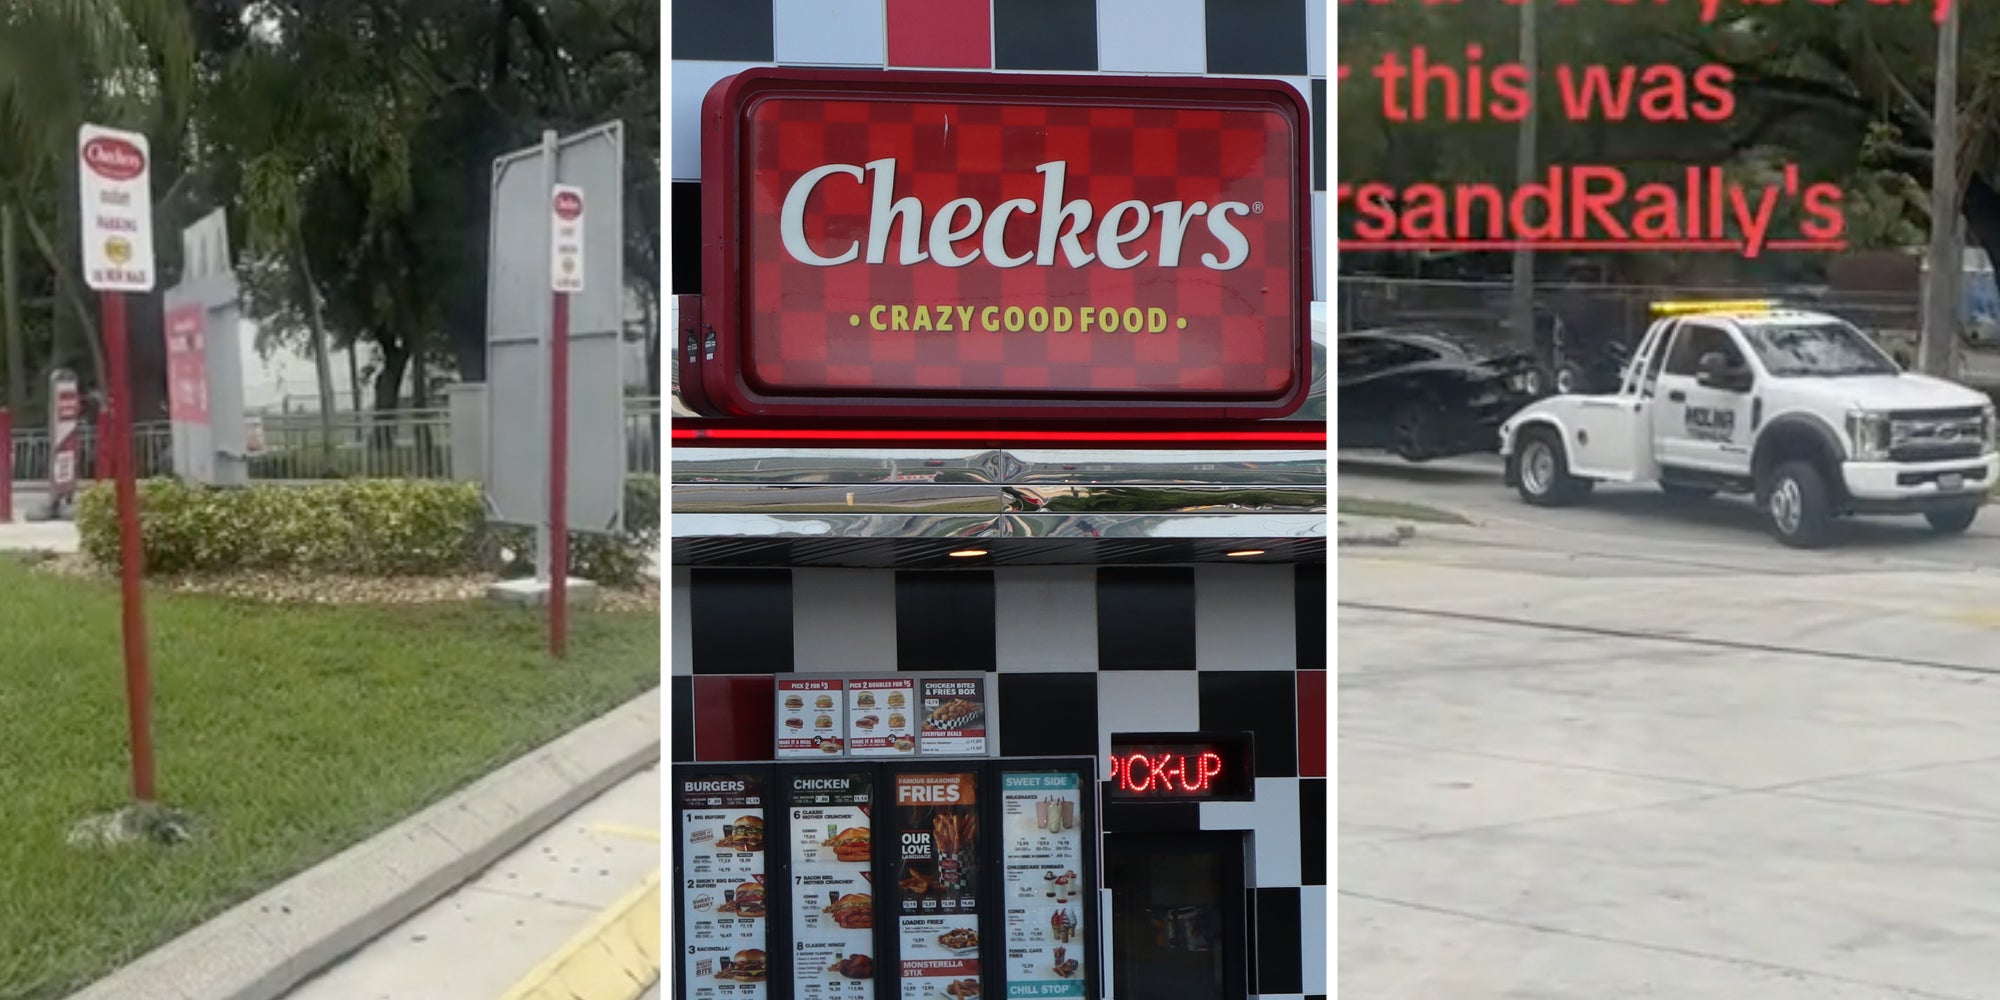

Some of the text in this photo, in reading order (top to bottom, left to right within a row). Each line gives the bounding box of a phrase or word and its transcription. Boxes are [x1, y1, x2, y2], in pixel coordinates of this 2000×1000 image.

[870, 304, 1168, 333] CRAZY GOOD FOOD
[804, 682, 810, 690] 2
[862, 681, 868, 689] 2
[685, 781, 745, 792] BURGERS
[793, 778, 850, 790] CHICKEN
[1006, 776, 1067, 787] SWEET SIDE
[899, 784, 960, 802] FRIES
[686, 813, 692, 822] 1
[793, 810, 801, 820] 6
[901, 833, 930, 844] OUR
[901, 844, 931, 855] LOVE
[687, 879, 695, 889] 2
[795, 876, 802, 885] 7
[688, 946, 695, 955] 3
[796, 941, 804, 951] 8
[903, 960, 964, 969] MONSTERELLA
[903, 969, 923, 977] STIX
[1010, 984, 1069, 995] CHILL STOP
